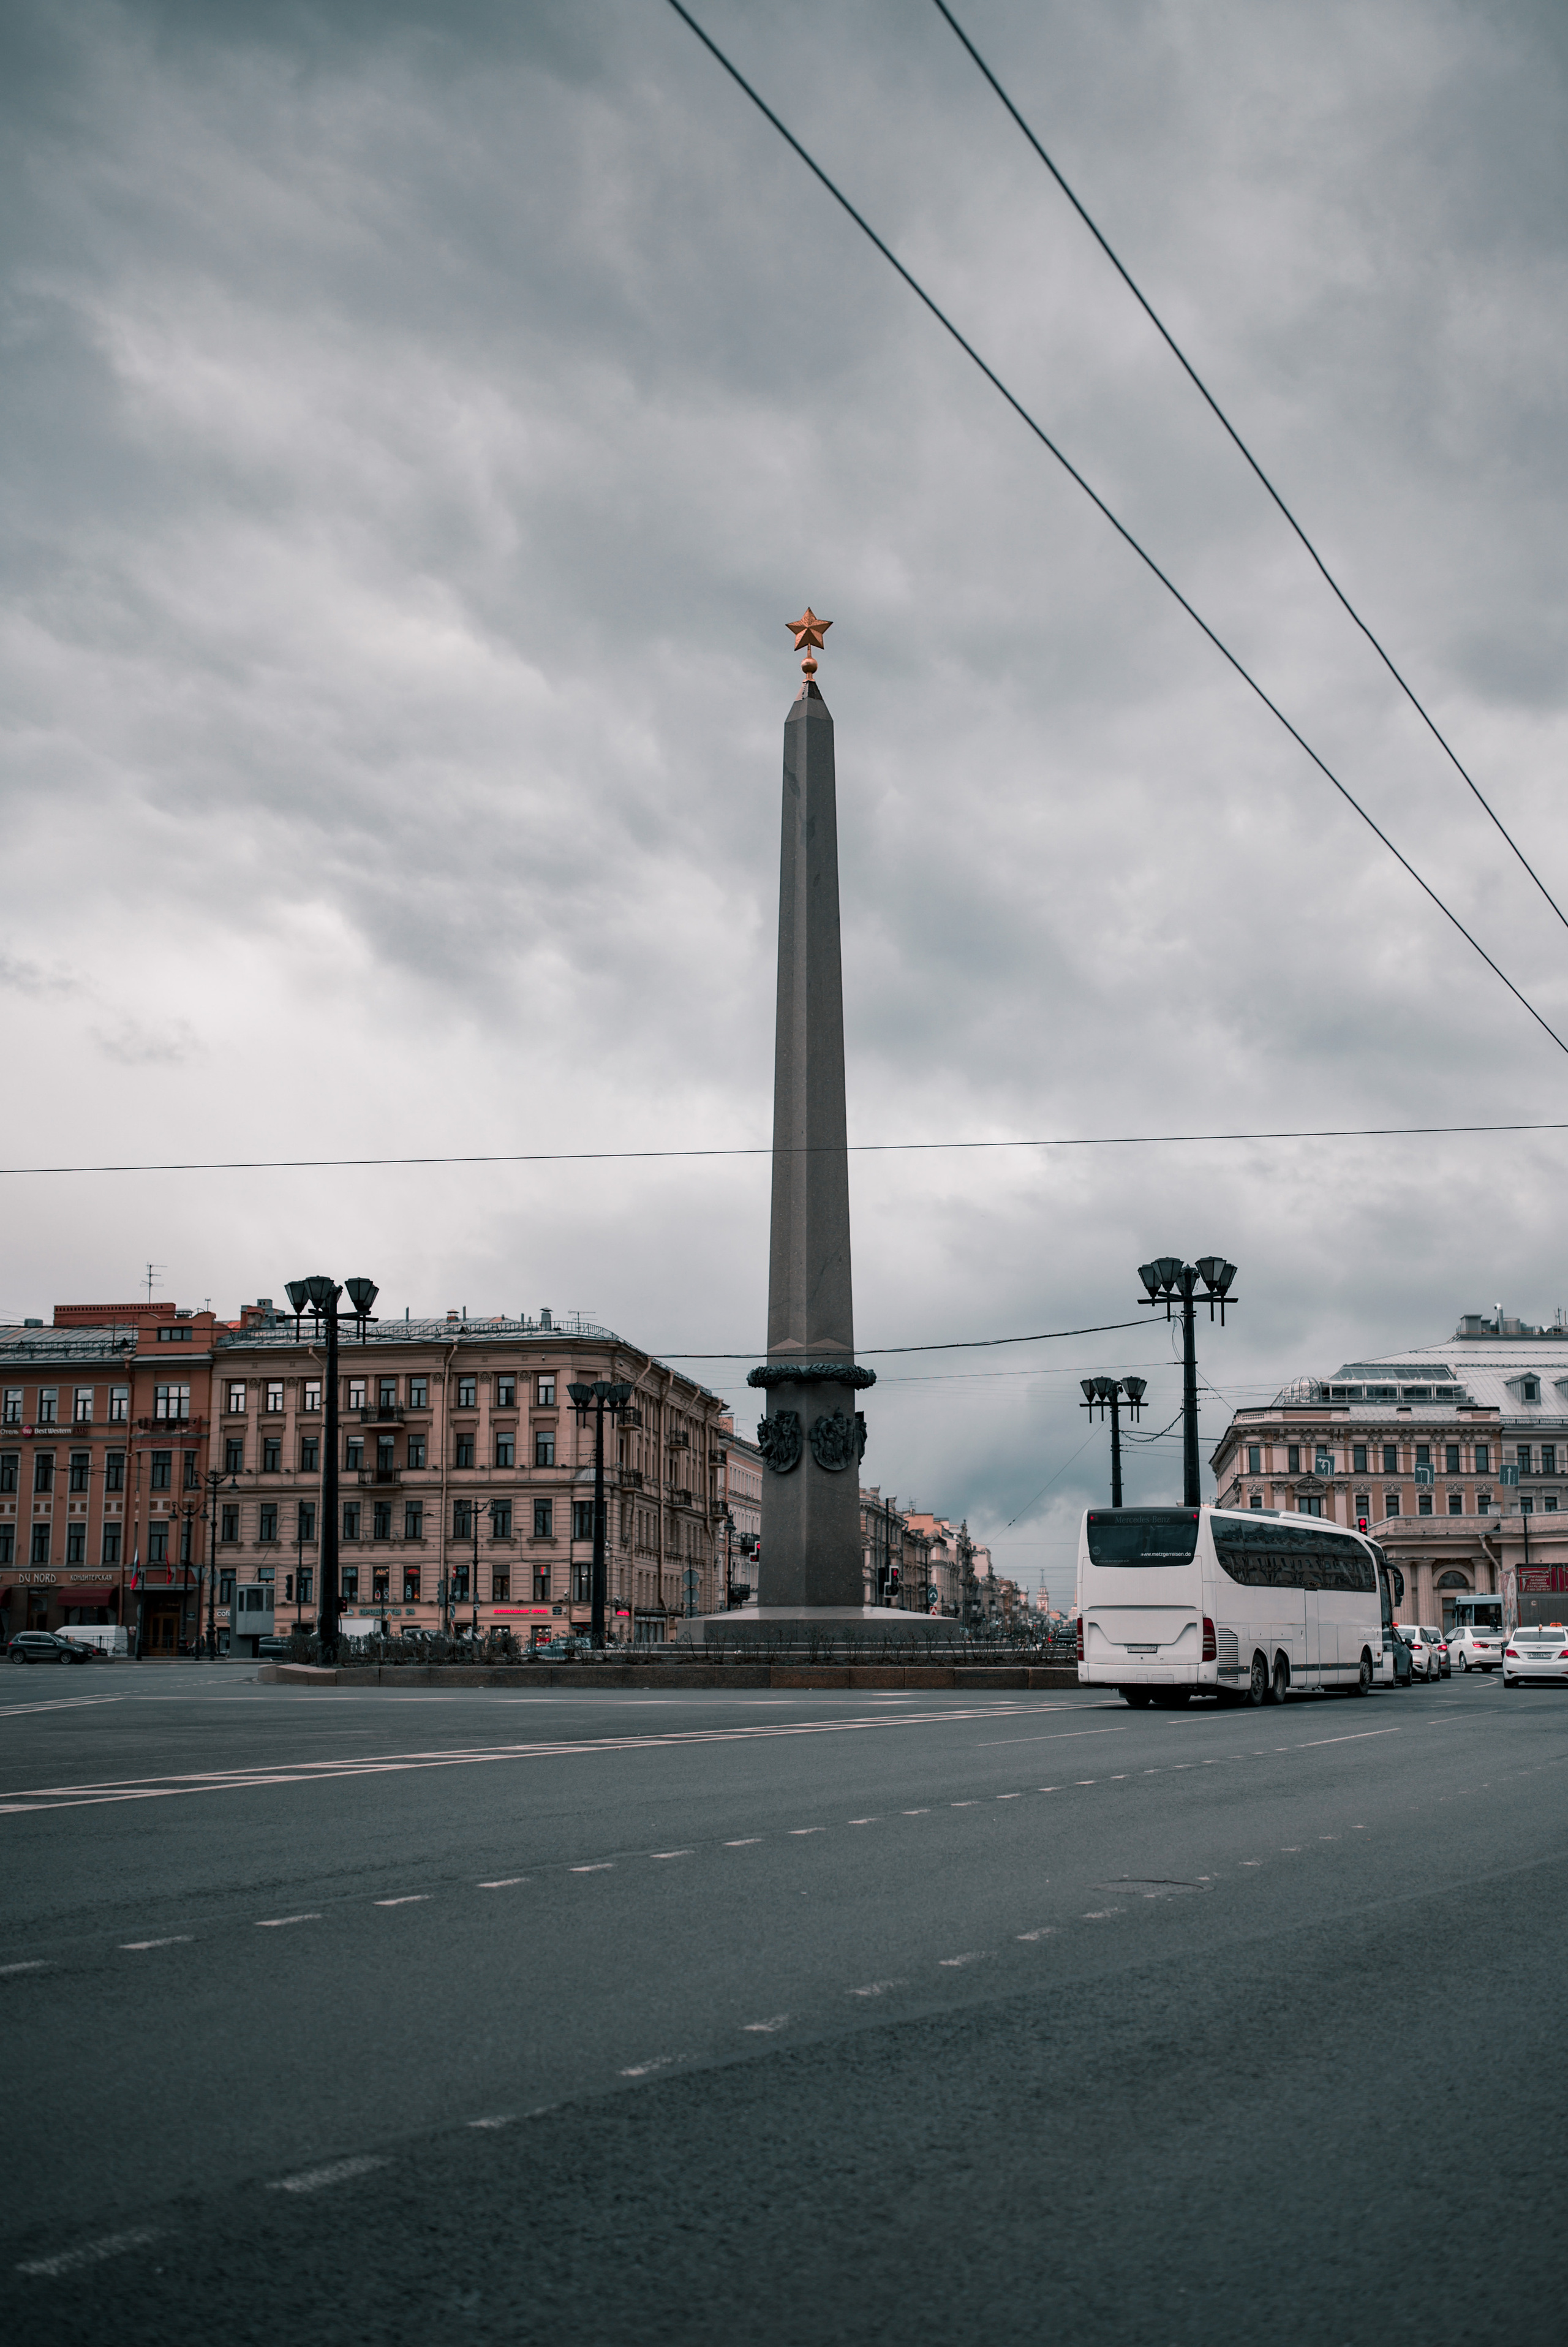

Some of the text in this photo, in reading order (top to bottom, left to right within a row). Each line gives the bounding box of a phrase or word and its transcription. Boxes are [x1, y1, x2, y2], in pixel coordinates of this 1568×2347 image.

[1115, 1515, 1170, 1524] Mercedes-Benz
[19, 1573, 56, 1583] DU NORD
